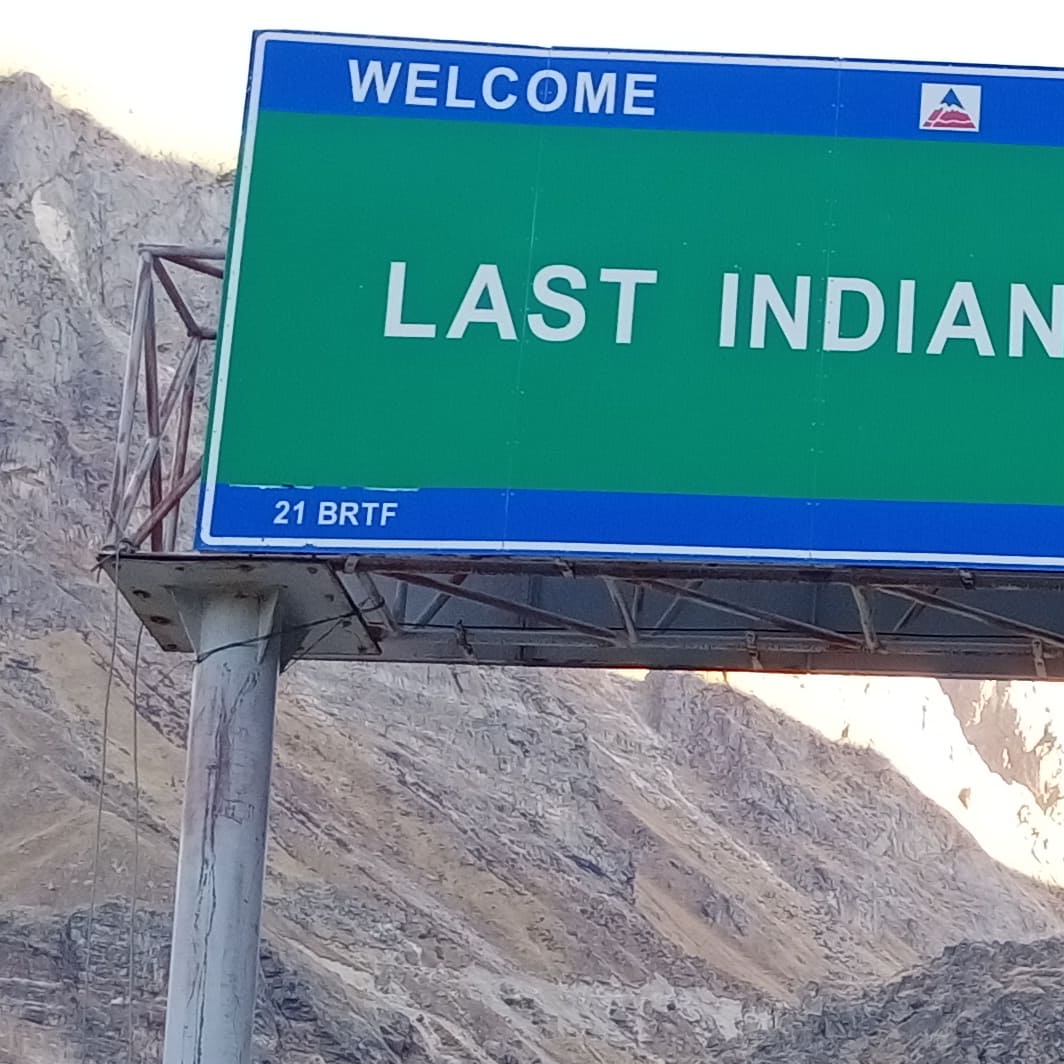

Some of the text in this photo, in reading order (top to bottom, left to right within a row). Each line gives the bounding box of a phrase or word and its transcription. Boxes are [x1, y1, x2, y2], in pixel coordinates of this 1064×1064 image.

[349, 59, 657, 117] WELCOME
[384, 261, 658, 344] LAST
[273, 500, 398, 527] 21 BRTF
